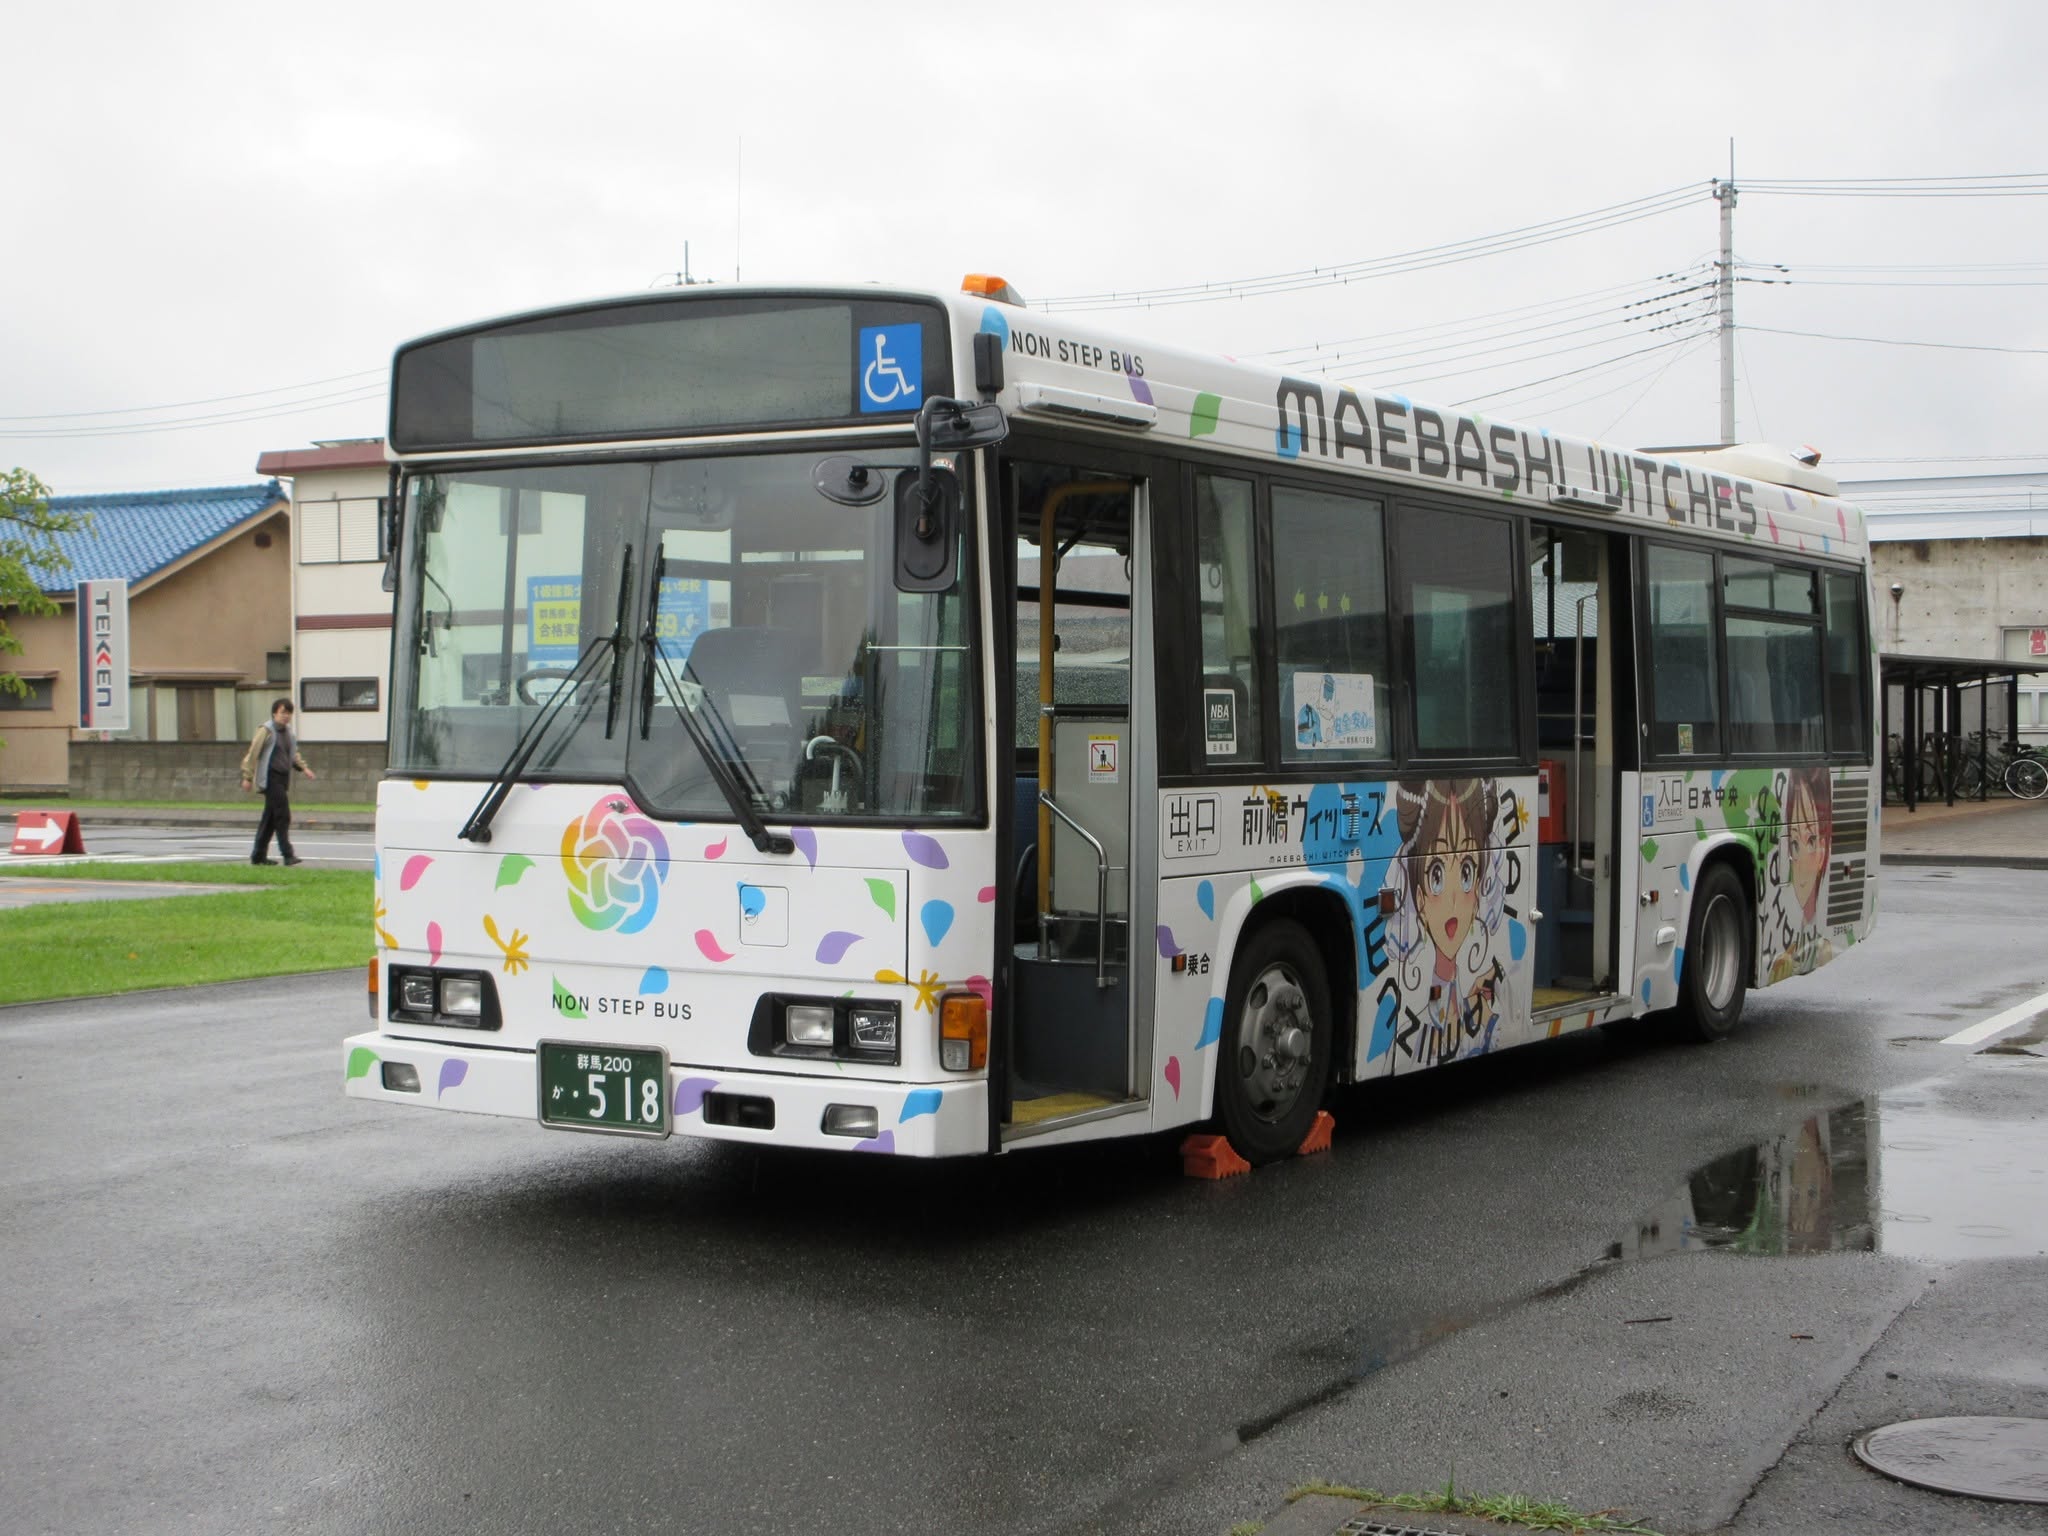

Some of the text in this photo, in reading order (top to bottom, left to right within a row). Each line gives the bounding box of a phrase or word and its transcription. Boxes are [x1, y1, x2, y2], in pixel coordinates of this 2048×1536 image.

[1011, 329, 1145, 377] NON STEP BUS
[1277, 376, 1567, 495] MAEBASHI
[1210, 703, 1230, 719] NBA
[1658, 779, 1682, 807] 入口
[1688, 785, 1738, 810] 日本中央
[1169, 795, 1216, 840] 出口
[1241, 790, 1386, 846] 前橋ウィッチーズ
[1657, 807, 1683, 818] ENTRANCE
[1177, 838, 1208, 852] EXIT
[1269, 848, 1361, 864] MAEBASHI WITCHES
[1187, 952, 1211, 977] 乗合
[552, 993, 692, 1020] NON STEP BUS
